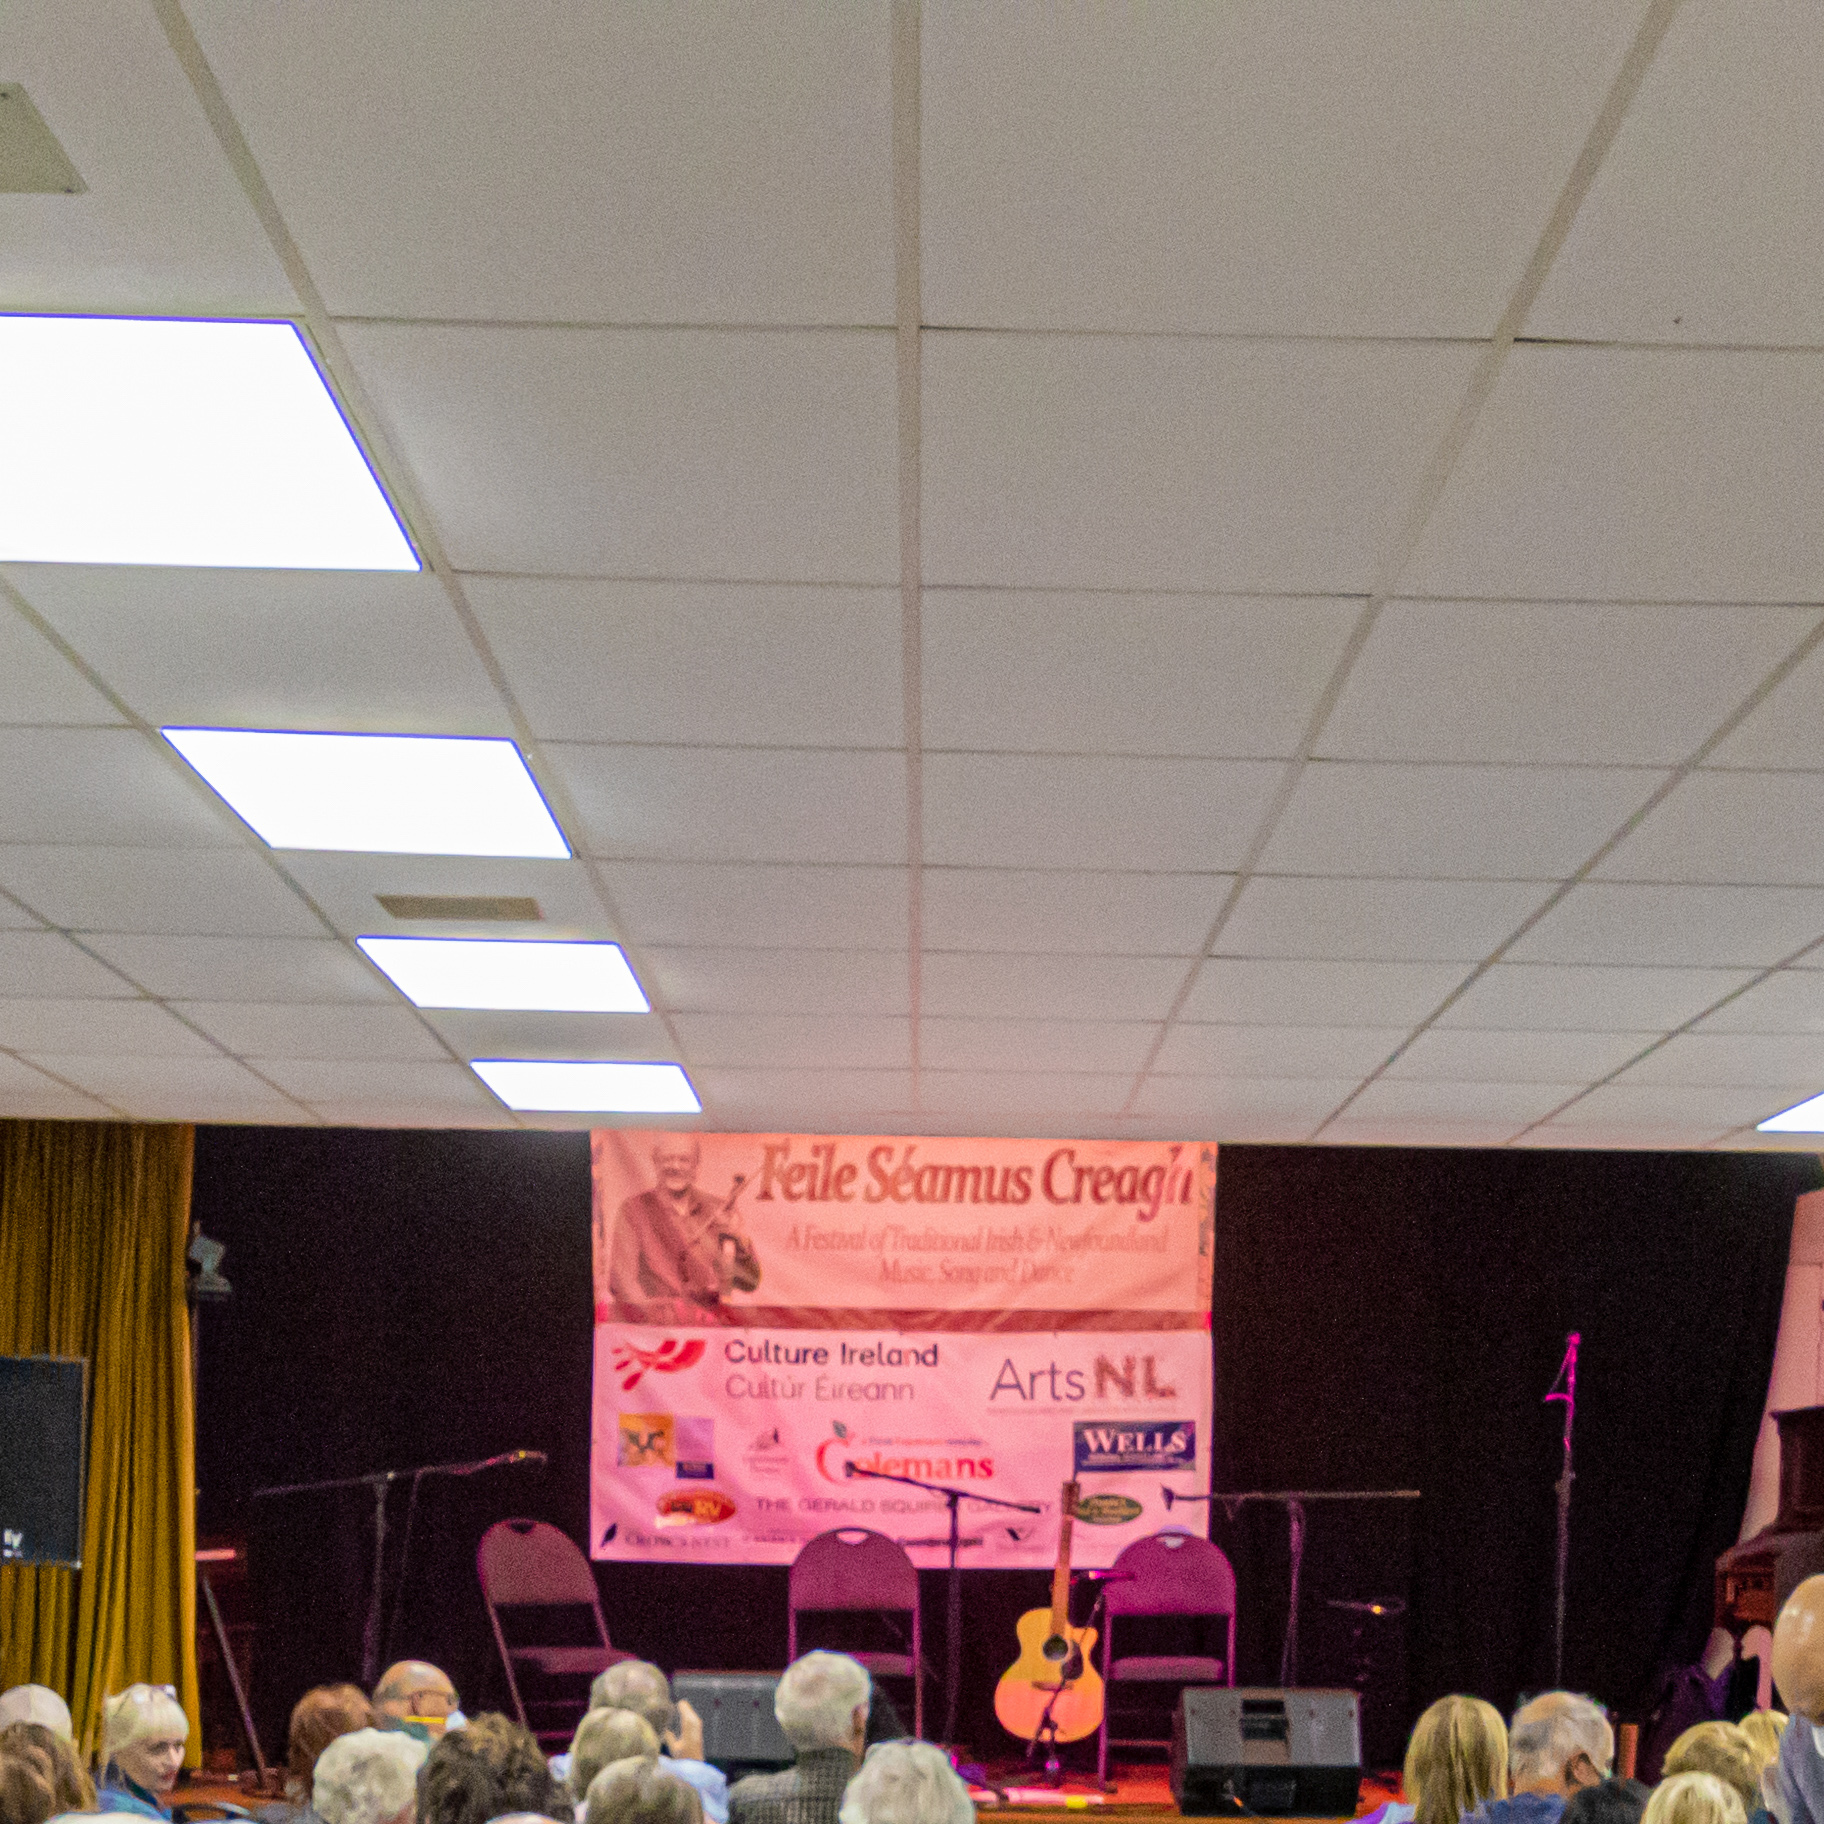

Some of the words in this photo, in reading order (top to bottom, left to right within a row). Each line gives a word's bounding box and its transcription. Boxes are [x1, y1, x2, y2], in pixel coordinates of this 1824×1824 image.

[1041, 1145, 1194, 1223] Creagh
[785, 1225, 800, 1251] A
[725, 1340, 828, 1365] Culture
[841, 1342, 939, 1367] Ireland
[726, 1374, 805, 1400] Cultúr
[815, 1372, 914, 1402] Éireann
[757, 1496, 789, 1511] THE
[797, 1497, 875, 1513] GERALD
